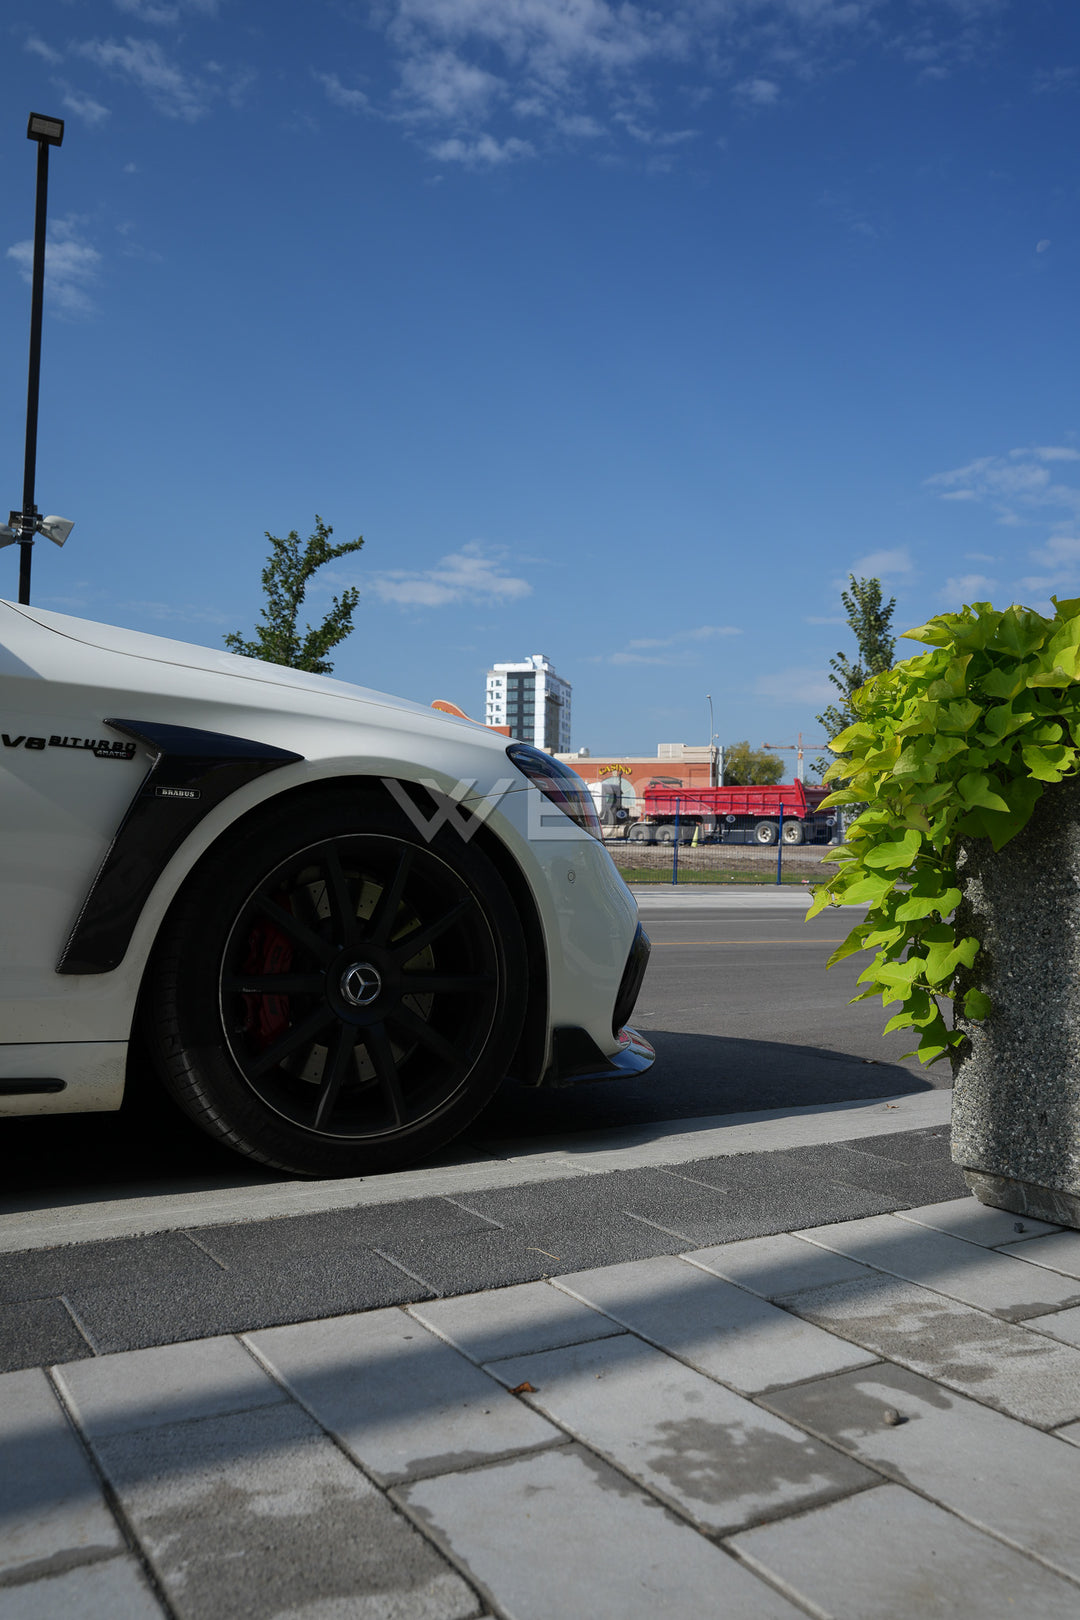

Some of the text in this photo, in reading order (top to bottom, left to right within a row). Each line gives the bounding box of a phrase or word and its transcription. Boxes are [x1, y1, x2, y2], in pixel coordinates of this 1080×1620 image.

[1, 734, 137, 751] V8 BITURBO
[598, 763, 632, 775] CASINO
[162, 788, 195, 798] BRABUS
